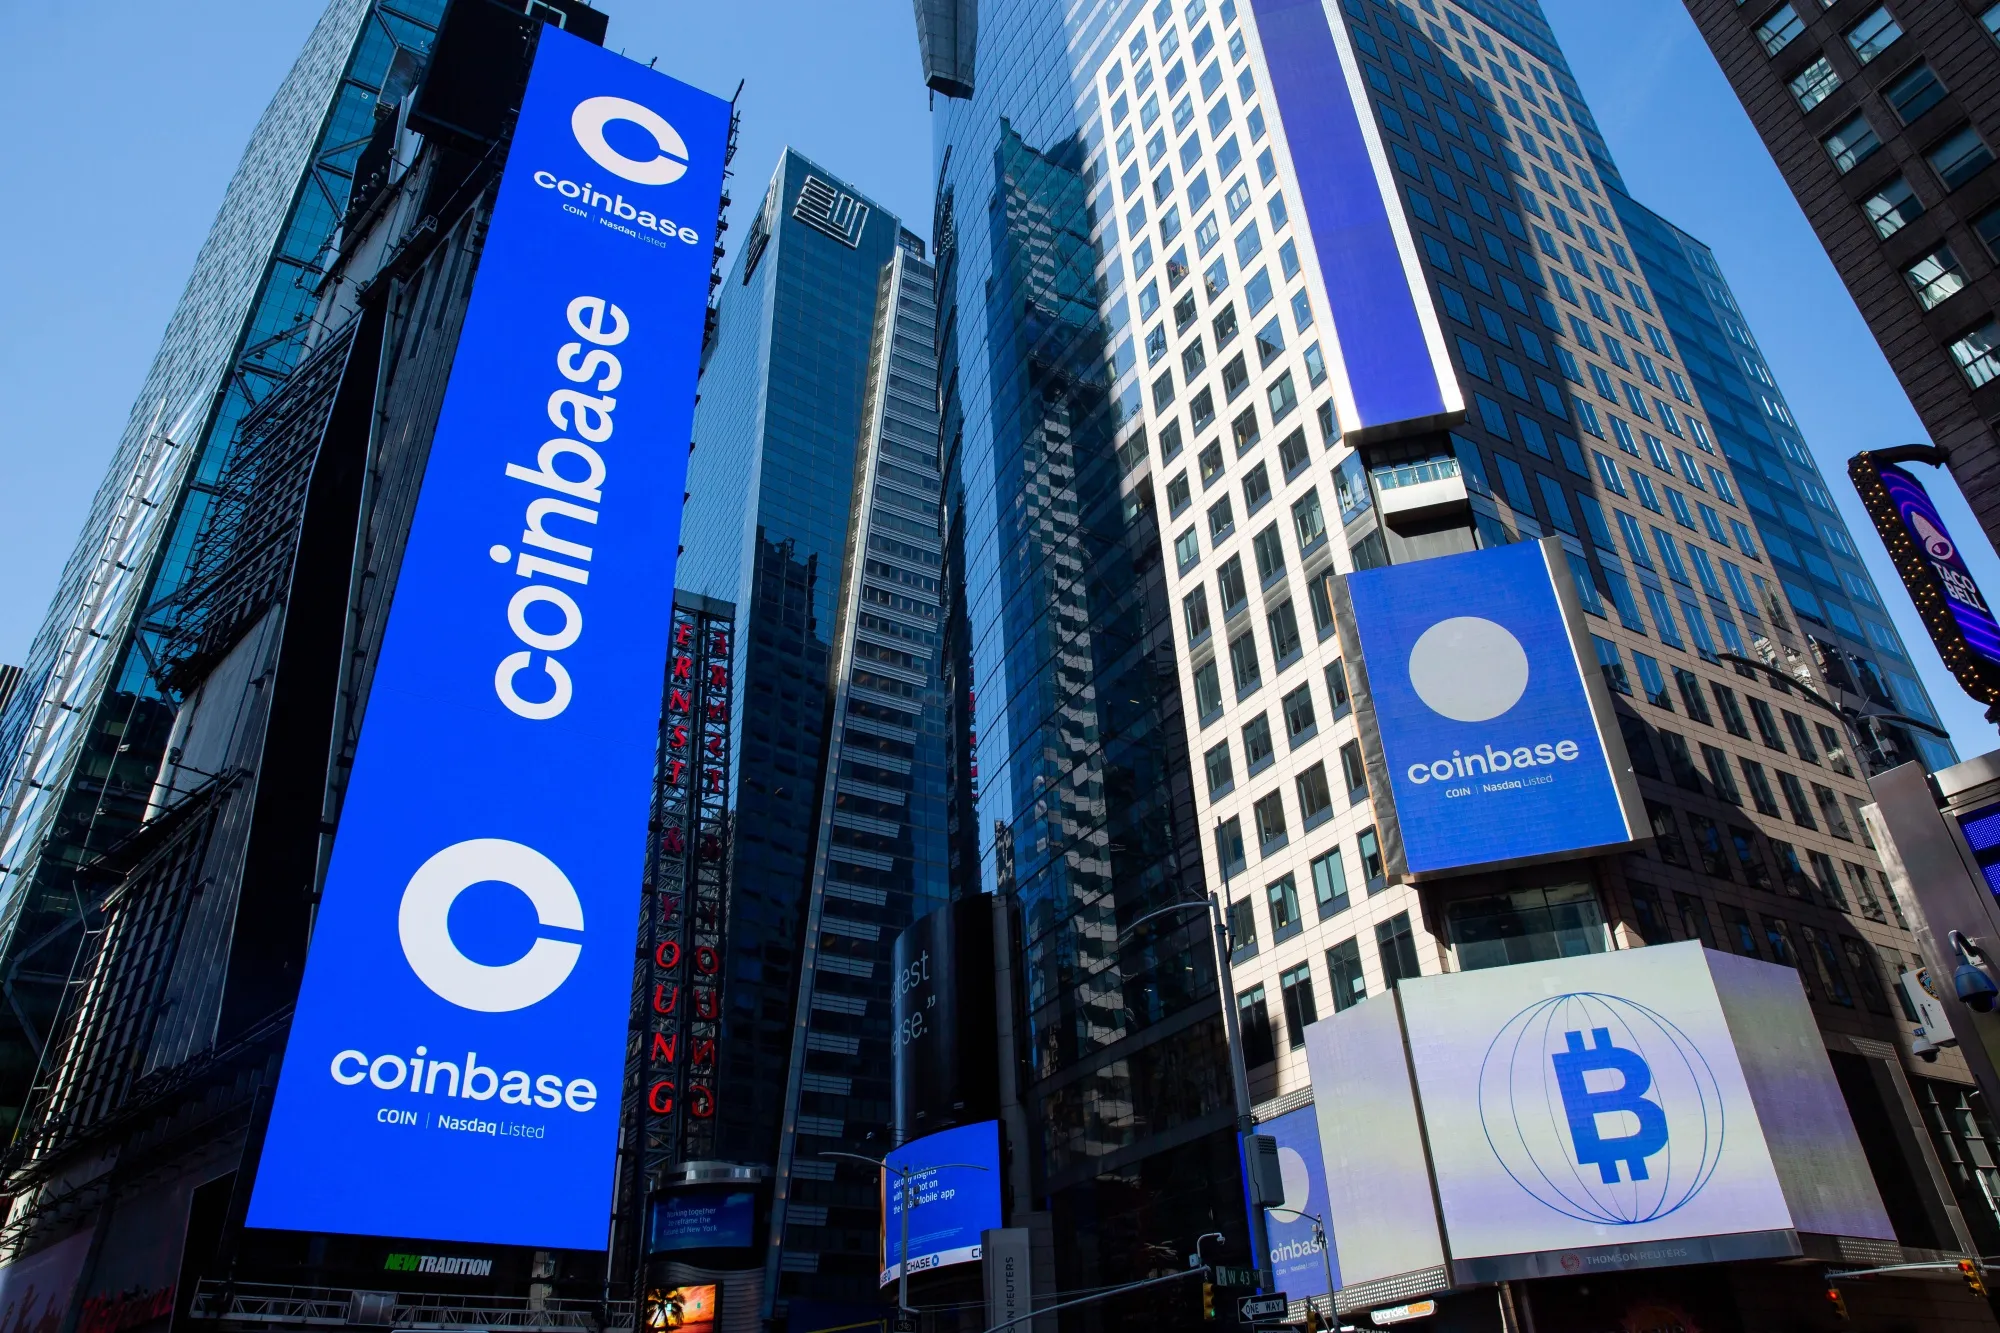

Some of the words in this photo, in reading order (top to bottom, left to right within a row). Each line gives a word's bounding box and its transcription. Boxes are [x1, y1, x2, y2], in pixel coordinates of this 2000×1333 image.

[533, 170, 699, 245] coinbase
[562, 203, 588, 218] COIN
[600, 217, 636, 238] Nasdaq
[637, 231, 667, 248] Listed
[489, 295, 630, 720] coinbase
[1931, 560, 1976, 594] TACO
[1943, 581, 1988, 613] BELL
[668, 622, 694, 786] ERNST
[1407, 739, 1580, 784] coinbase
[1445, 786, 1471, 799] COIN
[1482, 779, 1522, 793] Nasdaq
[1522, 773, 1553, 787] Listed
[648, 892, 681, 1116] YOUNG
[330, 1045, 598, 1112] coinbase
[376, 1108, 418, 1125] COIN
[437, 1115, 496, 1136] Nasdaq
[499, 1121, 545, 1139] Listed
[928, 1179, 938, 1188] on
[940, 1188, 955, 1201] app
[688, 1207, 717, 1217] together
[699, 1216, 711, 1224] the
[702, 1224, 718, 1232] York
[1585, 1252, 1638, 1266] THOMSON
[1639, 1247, 1687, 1261] REUTERS
[1005, 1256, 1015, 1307] REUTERS
[1227, 1269, 1236, 1285] W
[1239, 1270, 1251, 1286] 43
[1245, 1303, 1259, 1315] ONE
[1264, 1300, 1281, 1312] WAY
